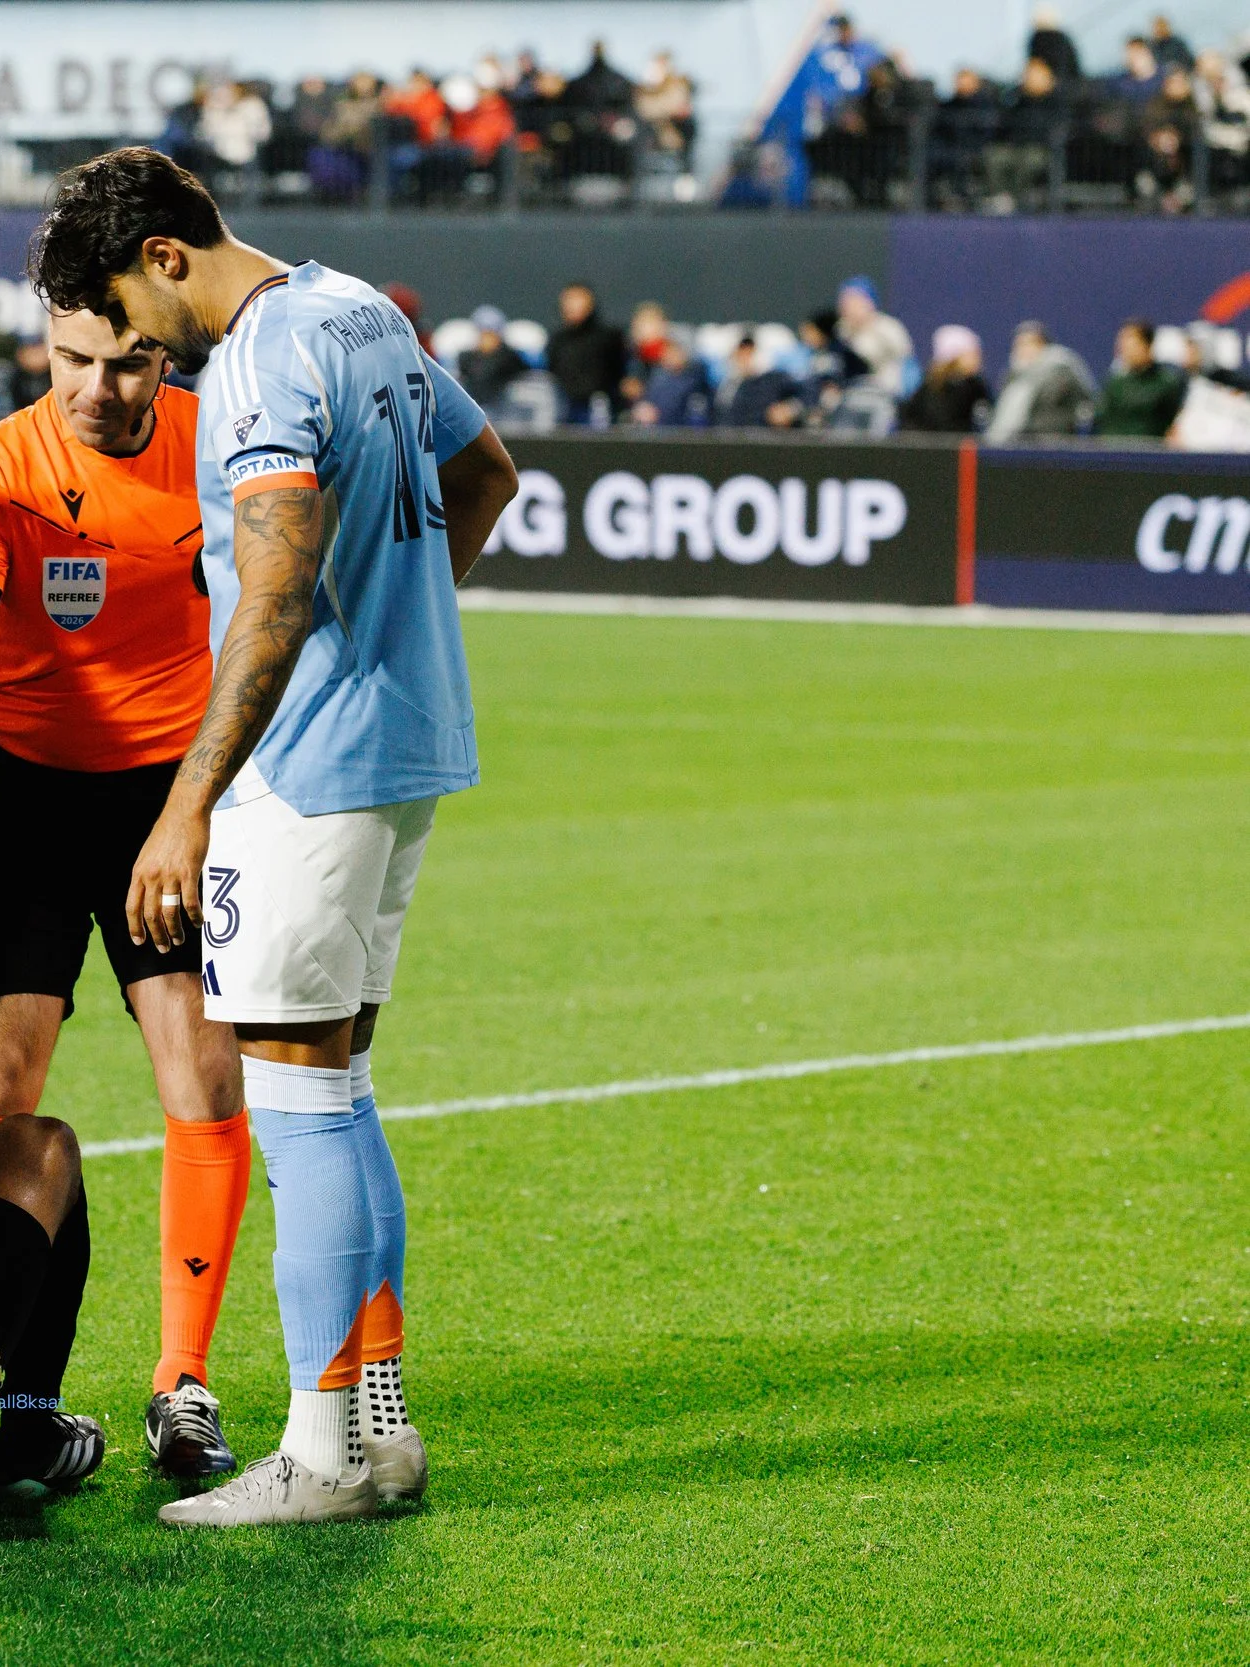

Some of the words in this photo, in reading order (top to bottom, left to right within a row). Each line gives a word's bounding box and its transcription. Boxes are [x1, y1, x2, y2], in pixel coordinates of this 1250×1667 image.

[320, 304, 384, 356] THIAGO
[234, 416, 254, 432] MLS
[230, 455, 299, 485] APTAIN
[584, 471, 908, 566] GROUP
[48, 562, 101, 581] FIFA
[47, 593, 100, 602] REFEREE
[60, 616, 84, 625] 2026
